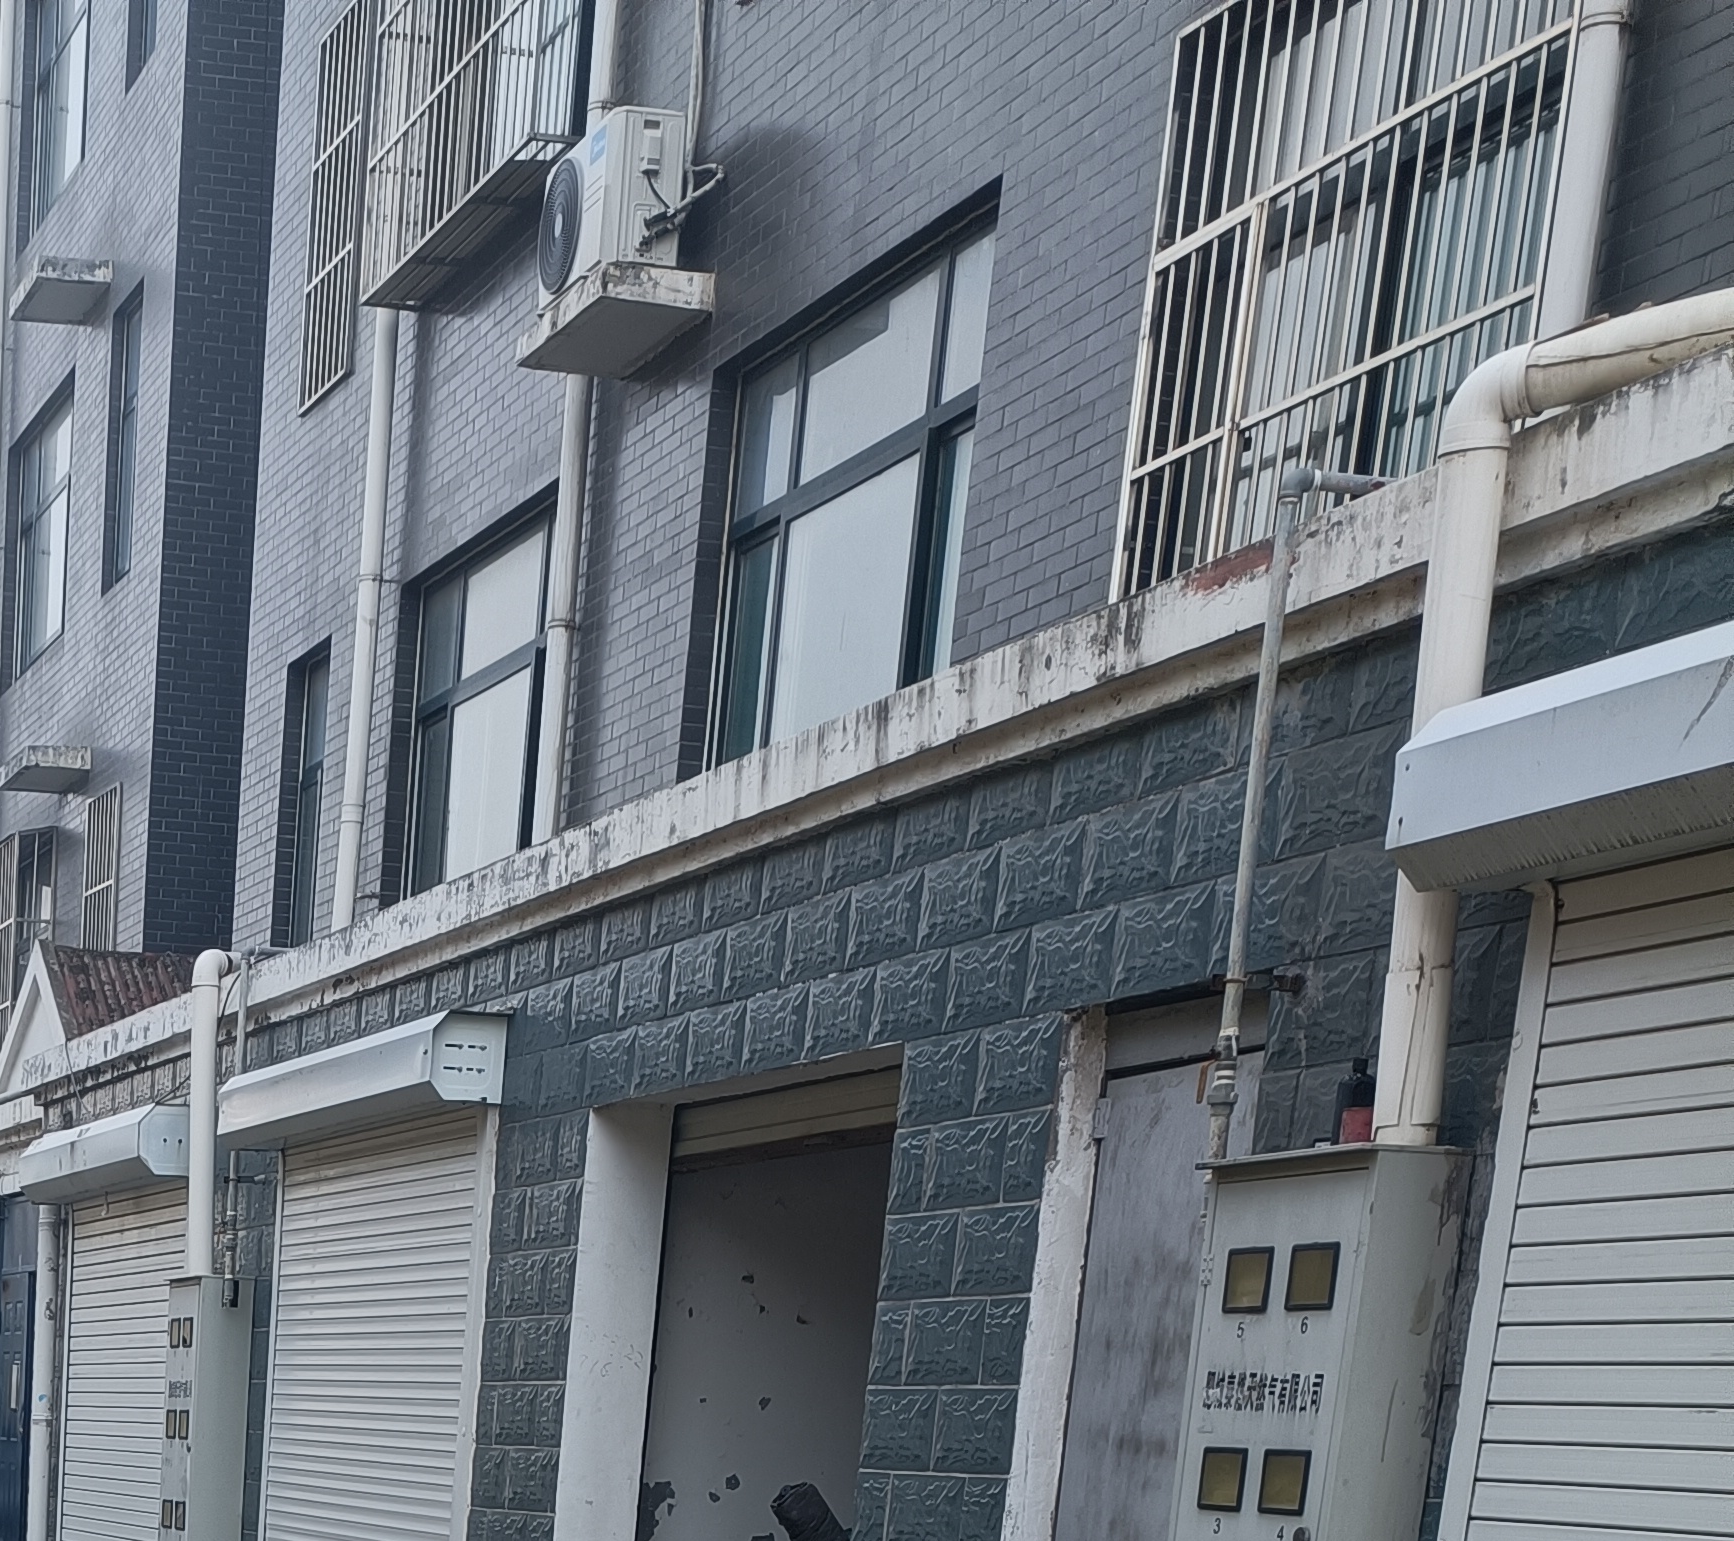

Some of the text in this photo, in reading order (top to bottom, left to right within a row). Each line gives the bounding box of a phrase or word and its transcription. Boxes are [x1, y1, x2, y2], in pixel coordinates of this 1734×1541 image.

[1236, 1321, 1245, 1338] 5
[1300, 1315, 1309, 1334] 6
[1213, 1517, 1222, 1534] 3
[1276, 1525, 1285, 1541] 4
